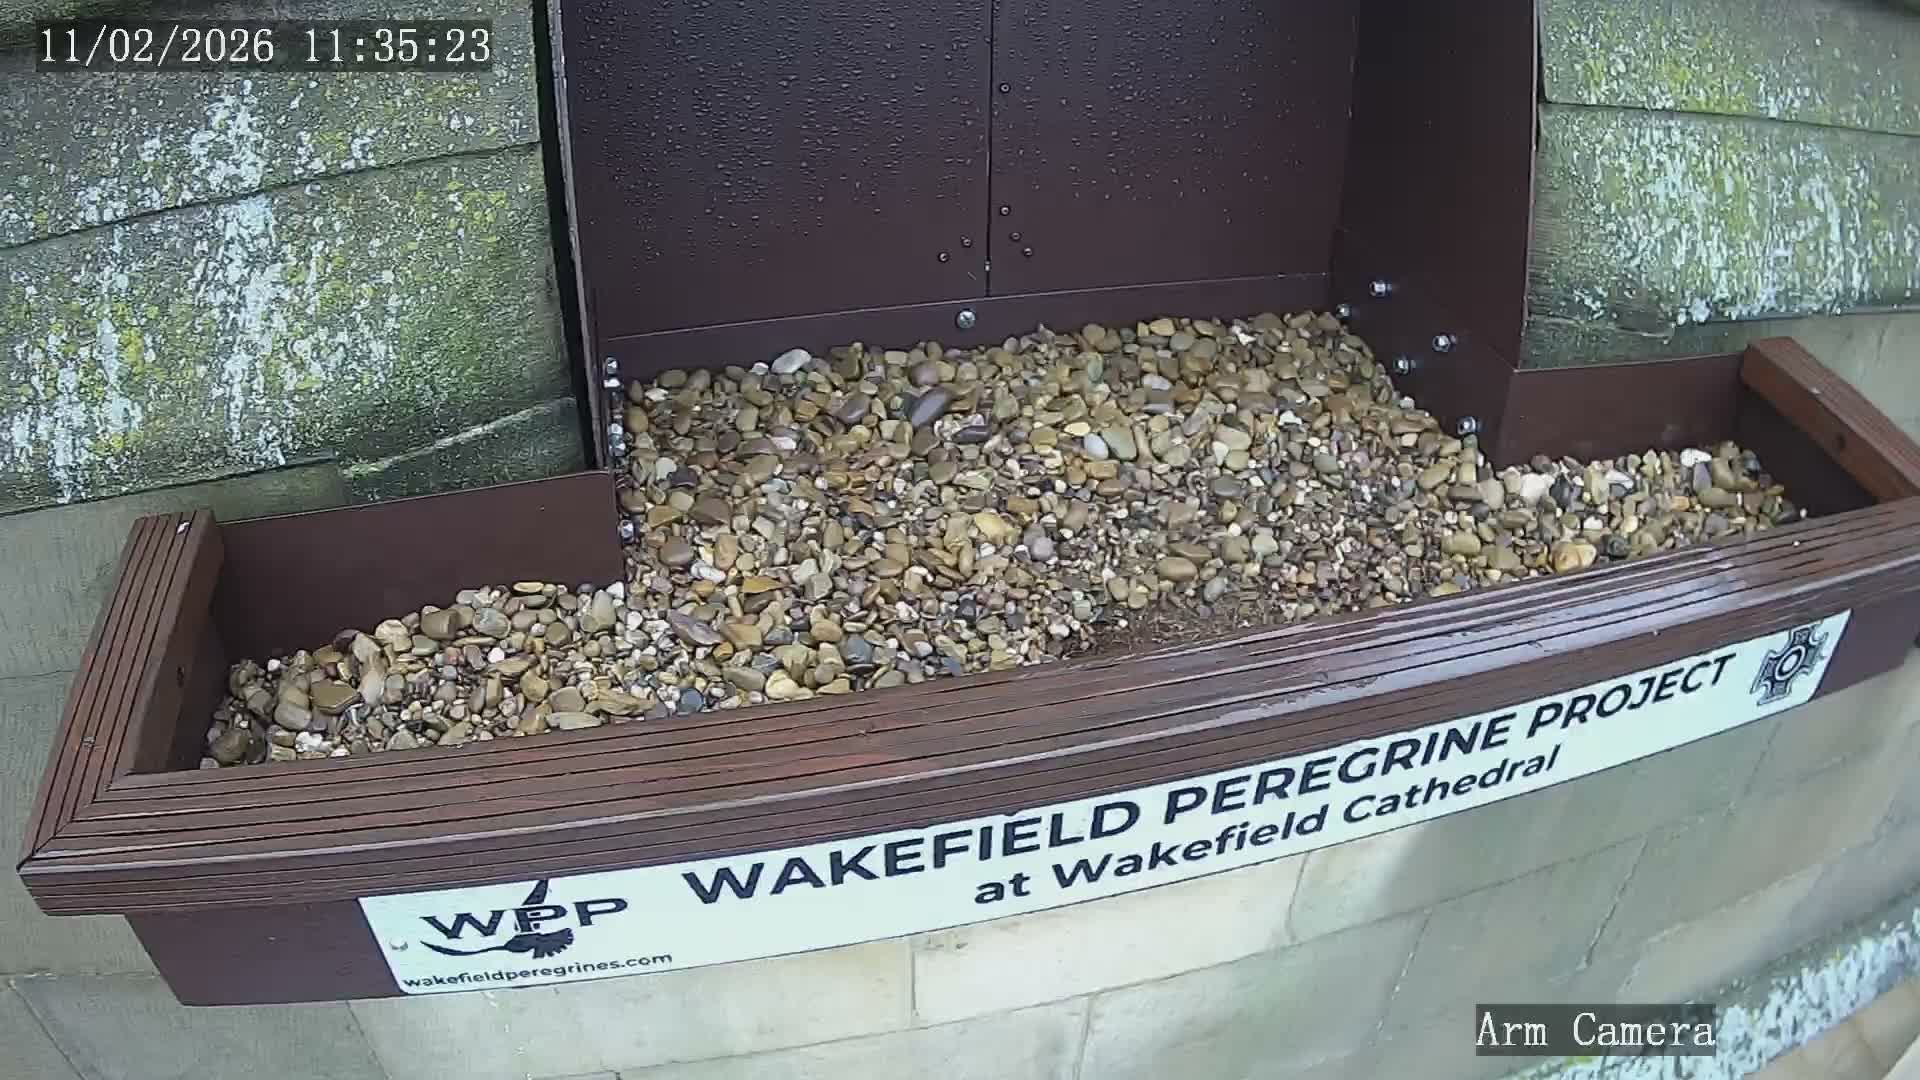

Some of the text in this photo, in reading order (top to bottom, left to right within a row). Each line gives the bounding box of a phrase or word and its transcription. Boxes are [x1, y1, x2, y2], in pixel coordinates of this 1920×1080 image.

[683, 653, 1736, 904] WAKEFIELD PEREGRINE PROJECT
[974, 745, 1561, 904] at Wakefield Cathedral
[420, 898, 629, 940] WPP
[403, 952, 673, 989] wakefieldperegrines.com
